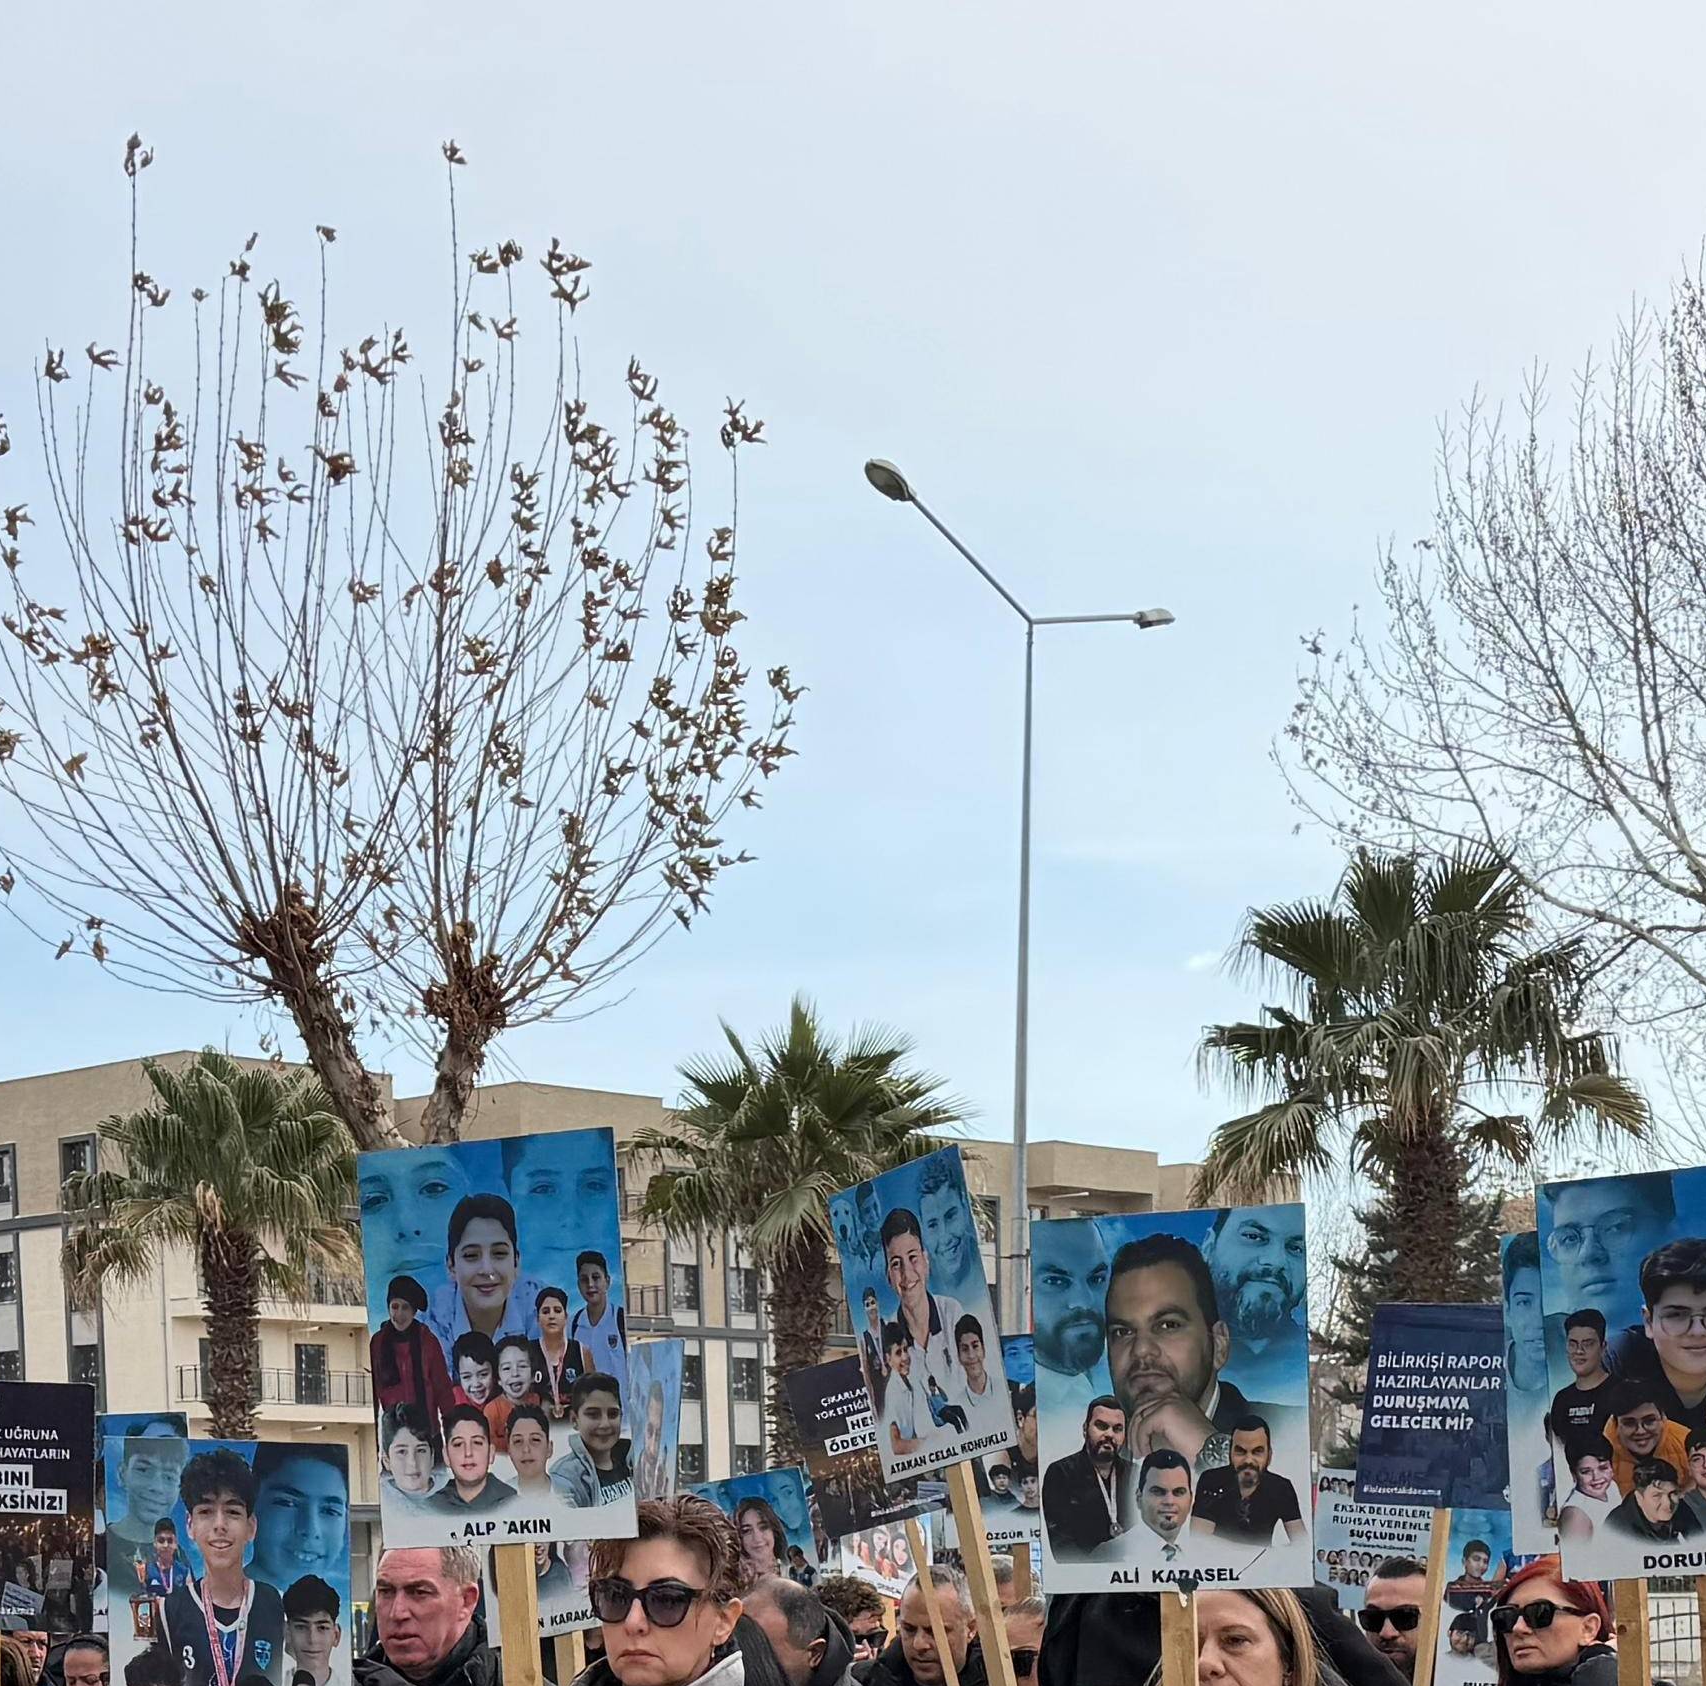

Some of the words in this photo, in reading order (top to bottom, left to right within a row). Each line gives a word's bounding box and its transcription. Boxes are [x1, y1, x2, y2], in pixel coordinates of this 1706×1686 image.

[1376, 1352, 1444, 1373] BİLİRKİŞİ
[1375, 1374, 1500, 1390] HAZIRLAYANLAR
[1372, 1395, 1470, 1414] DURUŞMAYA
[1370, 1414, 1442, 1430] GELECEK
[1445, 1414, 1475, 1431] Mİ?
[4, 1425, 58, 1441] UĞRUNA
[889, 1453, 927, 1476] ATAKAN
[928, 1444, 959, 1465] CELAL
[463, 1522, 496, 1537] ALP
[507, 1519, 551, 1535] AKIN
[1333, 1515, 1377, 1526] RUHSAT
[1349, 1529, 1417, 1543] SUÇLUDUR!
[1110, 1567, 1139, 1584] ALİ
[183, 1645, 196, 1670] 3
